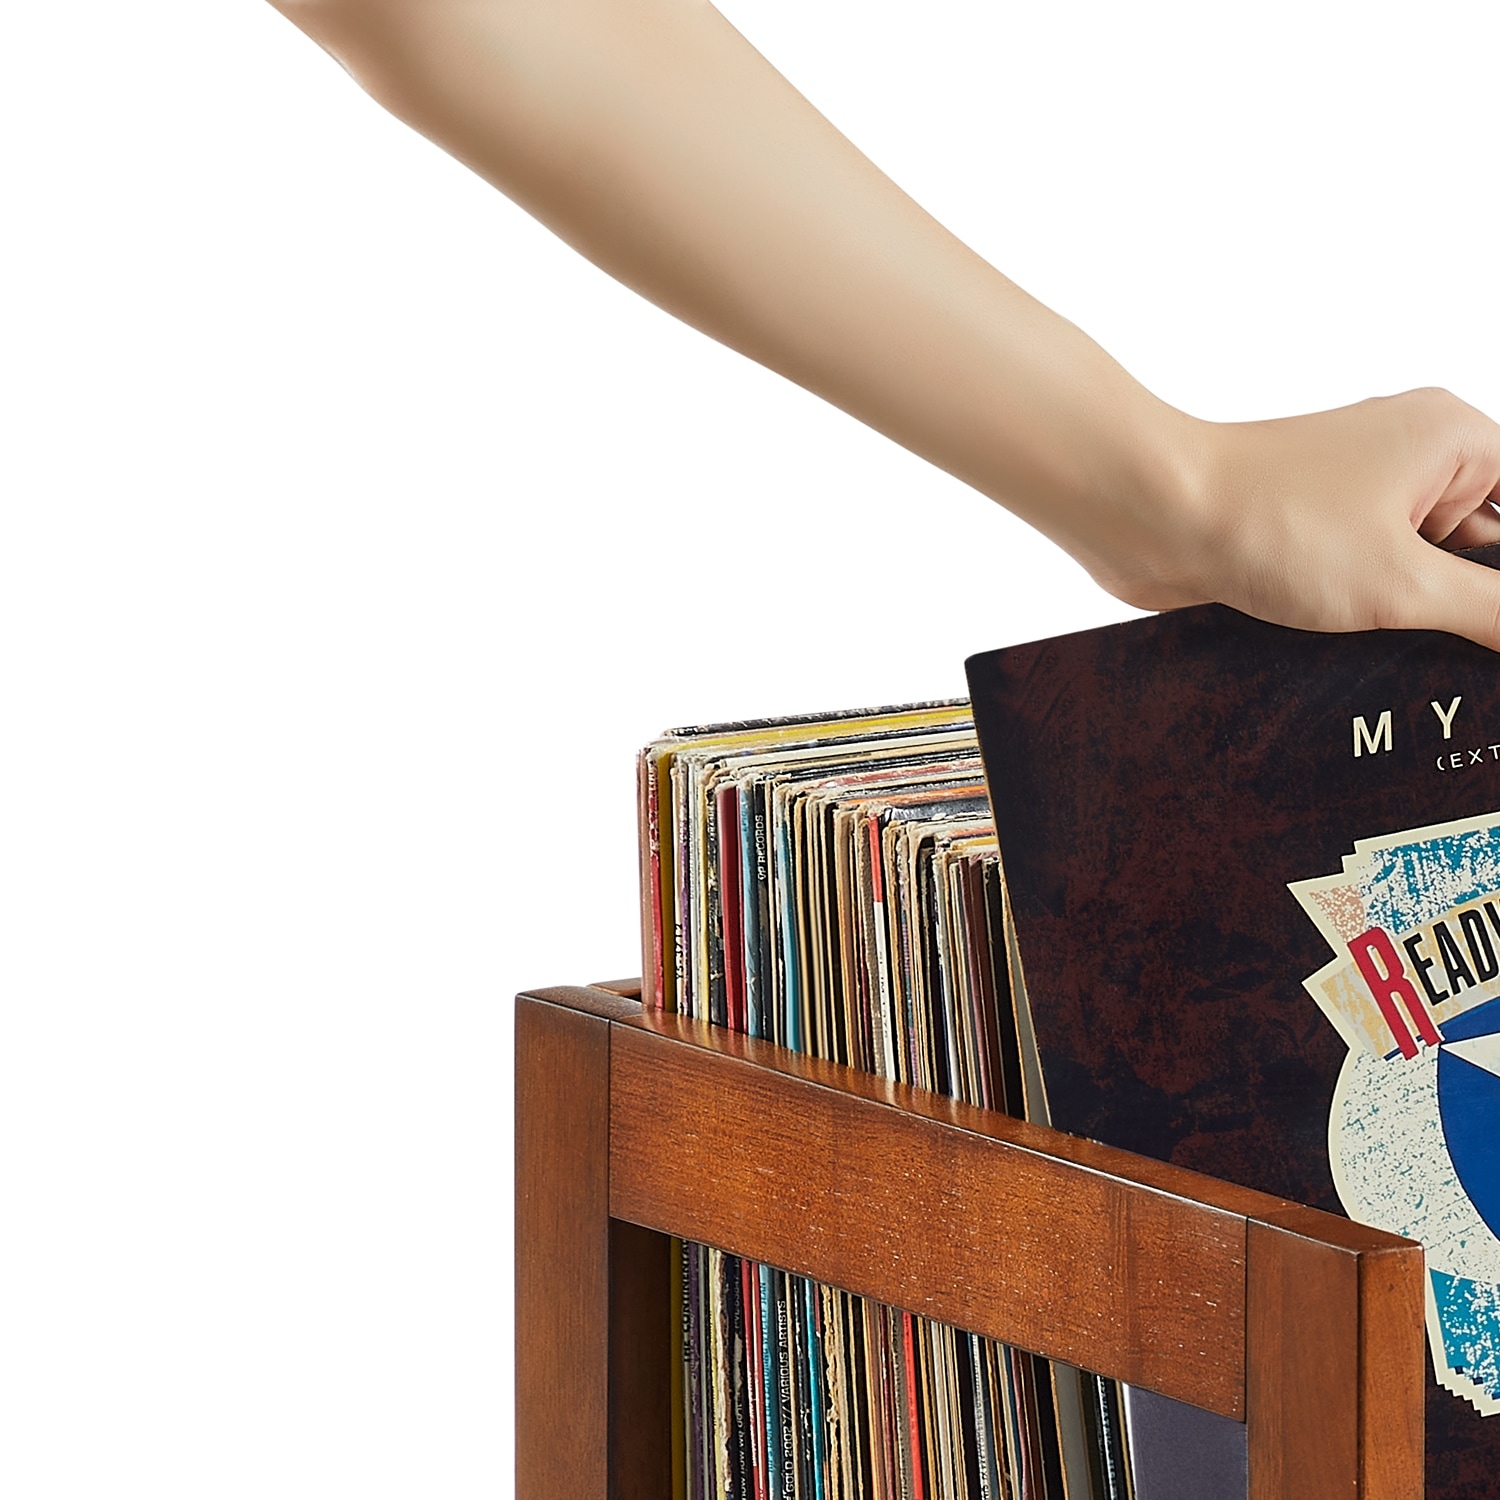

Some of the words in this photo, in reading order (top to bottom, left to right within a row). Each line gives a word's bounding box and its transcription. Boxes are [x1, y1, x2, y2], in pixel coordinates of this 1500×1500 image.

[1353, 697, 1463, 757] MY
[755, 814, 765, 862] RECORDS
[776, 1300, 787, 1347] ARTISTS
[778, 1351, 790, 1402] VARIOUS
[783, 1426, 793, 1456] 2002
[784, 1461, 794, 1491] GOLD
